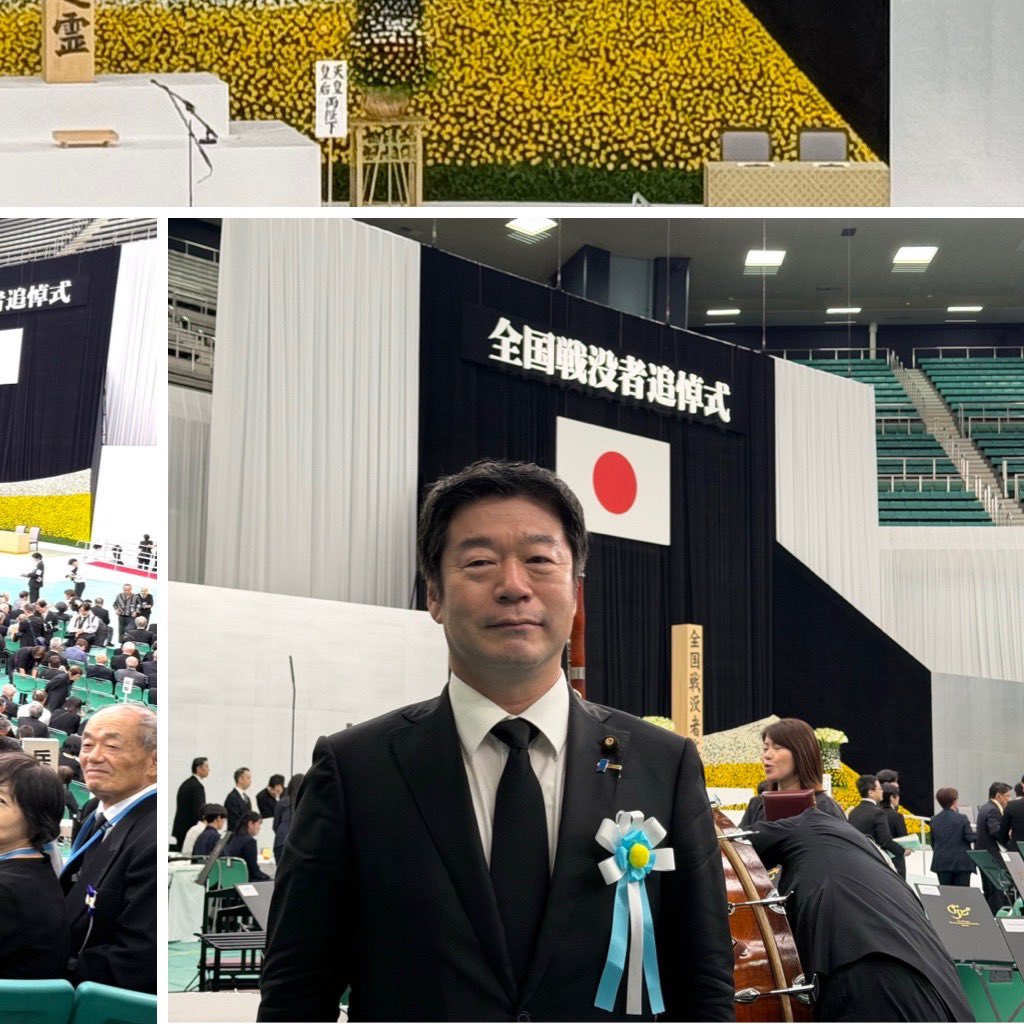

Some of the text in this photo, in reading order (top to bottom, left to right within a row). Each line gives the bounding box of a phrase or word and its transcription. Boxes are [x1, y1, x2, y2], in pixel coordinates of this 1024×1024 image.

[488, 316, 732, 424] 全国戦没者追悼式
